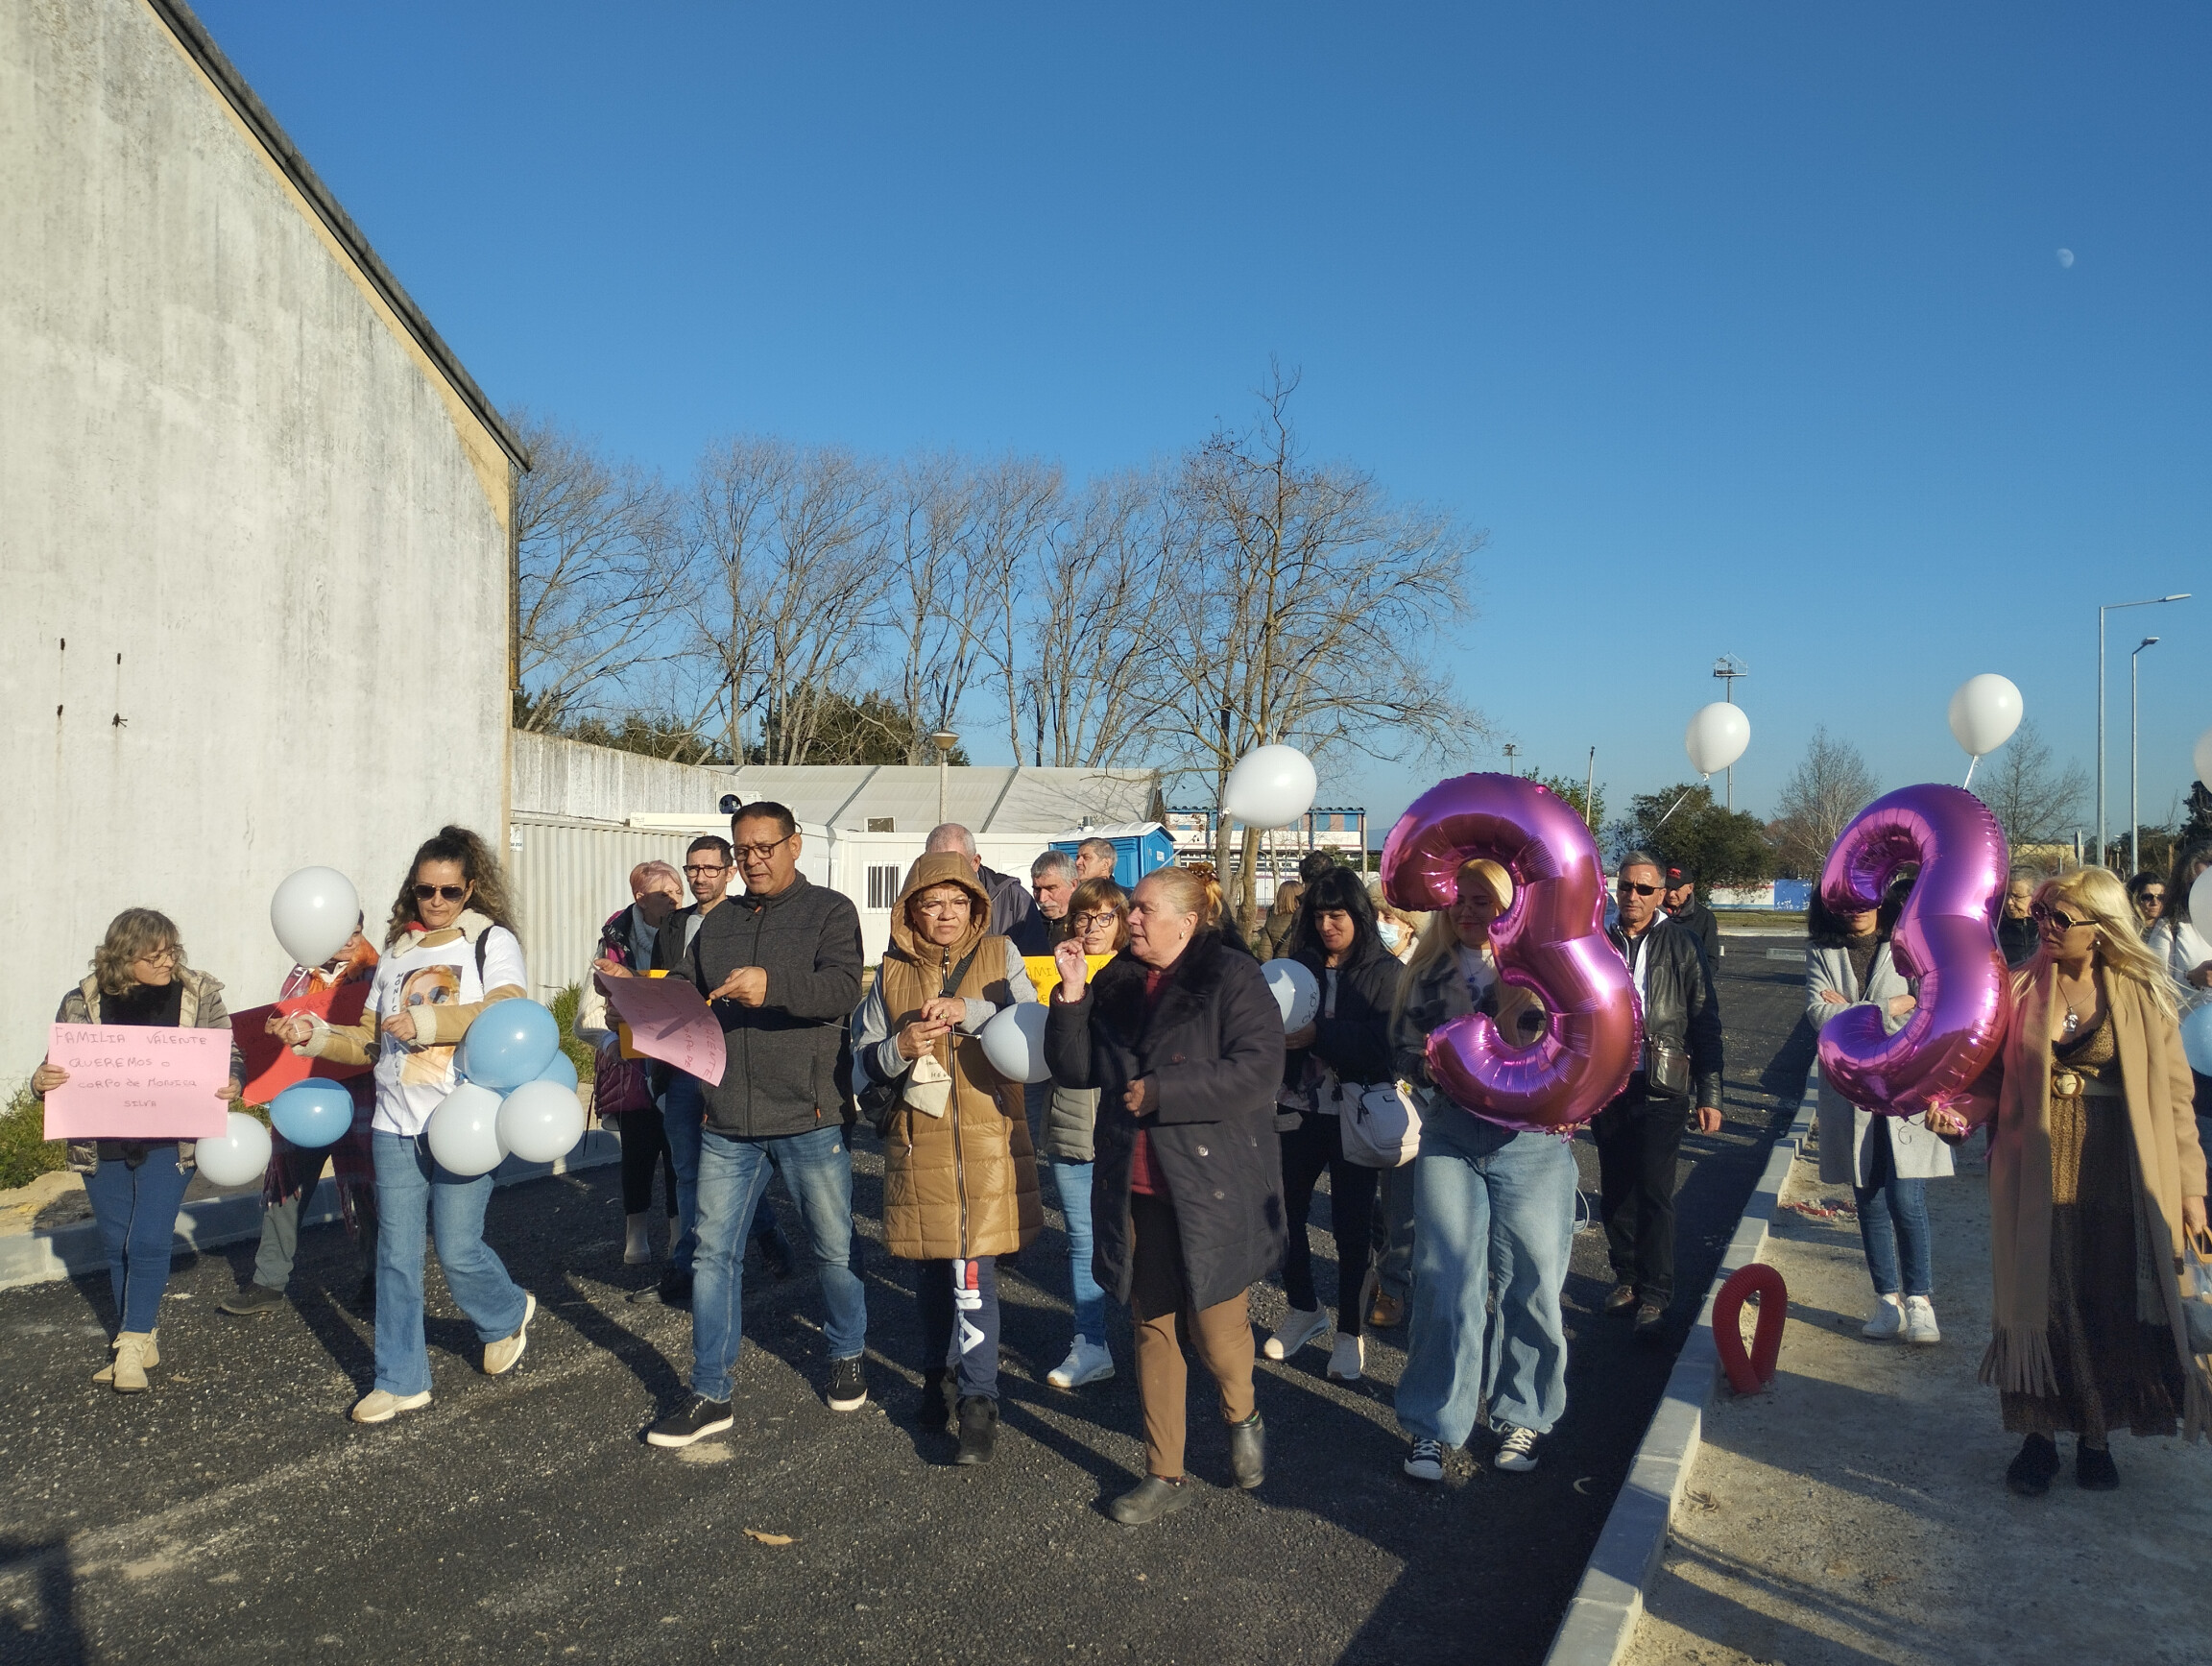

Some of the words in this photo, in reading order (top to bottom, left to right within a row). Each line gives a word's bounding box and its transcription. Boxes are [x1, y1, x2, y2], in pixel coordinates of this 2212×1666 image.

[55, 1026, 126, 1046] FAMILIA
[146, 1030, 207, 1045] VALENTE
[68, 1057, 153, 1068] QUEREMOS
[124, 1099, 156, 1108] SILVA
